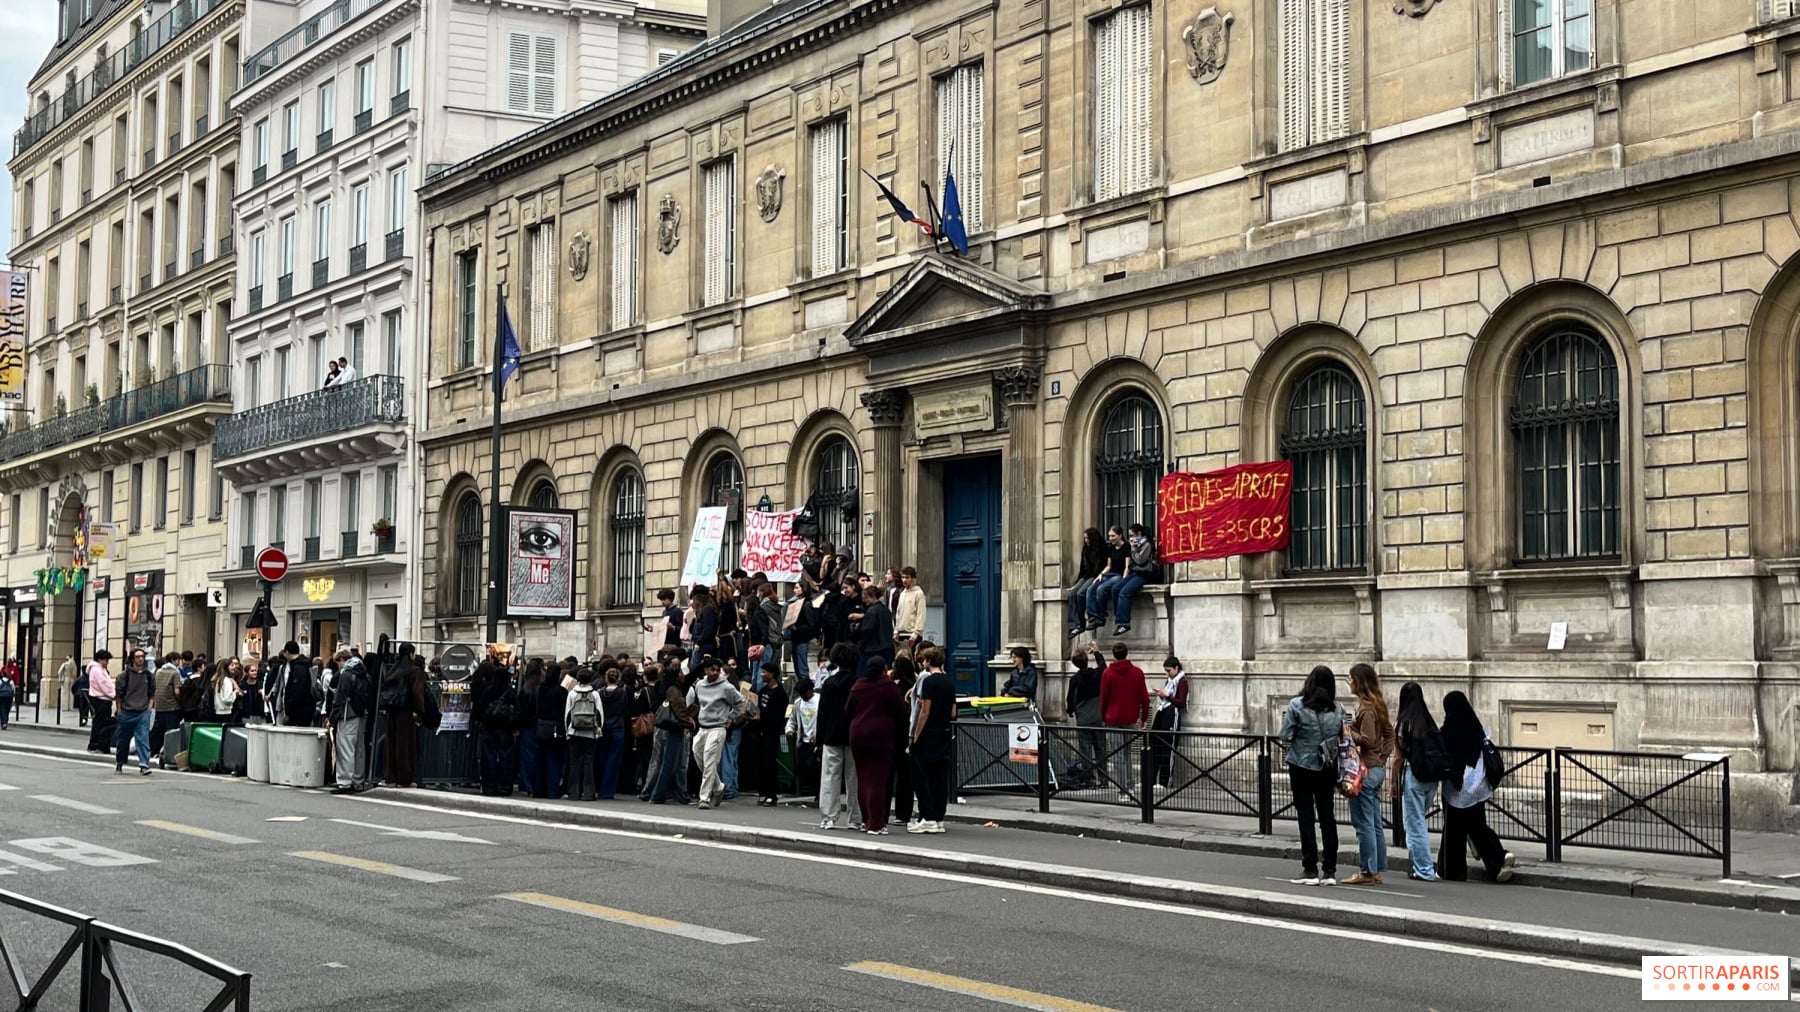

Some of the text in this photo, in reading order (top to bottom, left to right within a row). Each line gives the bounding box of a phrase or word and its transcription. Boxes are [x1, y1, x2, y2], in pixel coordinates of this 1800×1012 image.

[8, 275, 26, 369] DU HAVRE
[0, 391, 22, 400] nac
[745, 510, 798, 532] SOUTIE
[530, 564, 550, 583] Me
